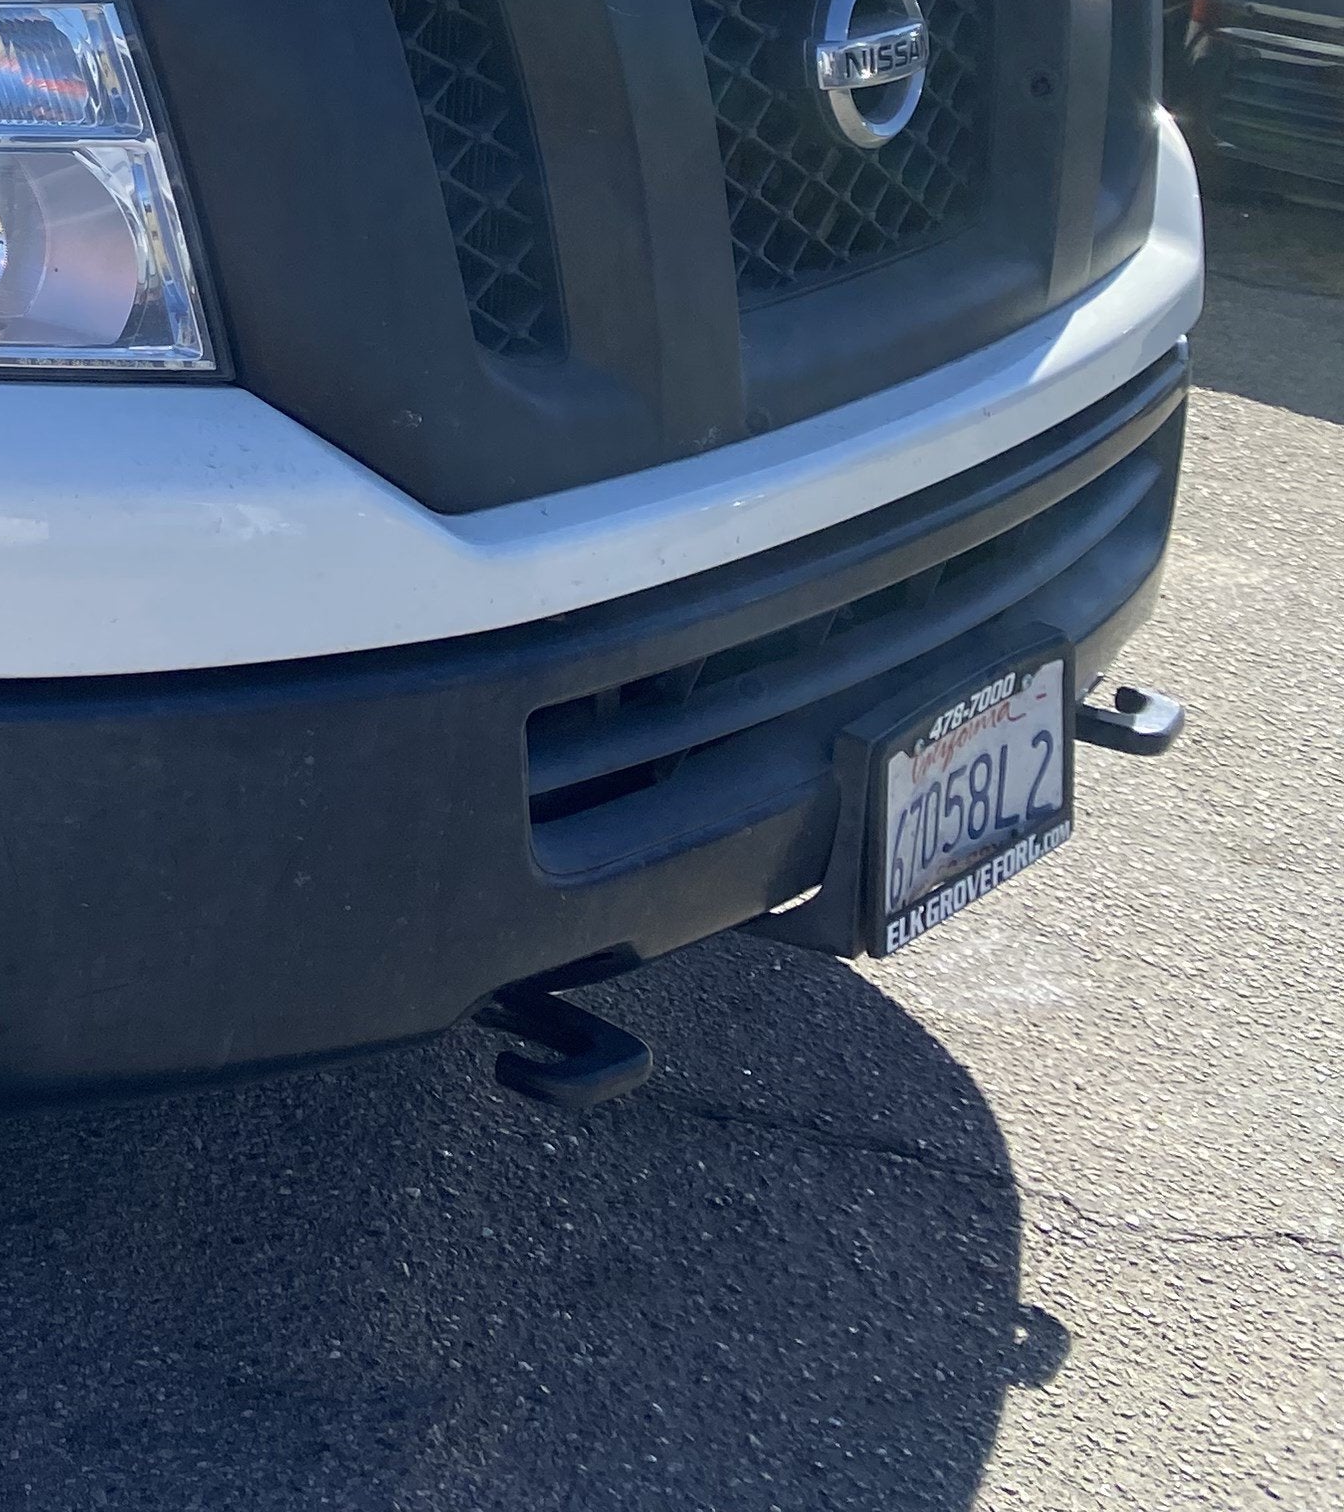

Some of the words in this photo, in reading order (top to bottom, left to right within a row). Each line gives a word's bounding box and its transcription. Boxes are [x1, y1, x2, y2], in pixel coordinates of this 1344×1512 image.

[843, 37, 923, 79] NISSA
[928, 671, 1017, 741] 478-7000
[888, 728, 1055, 914] 67058L2
